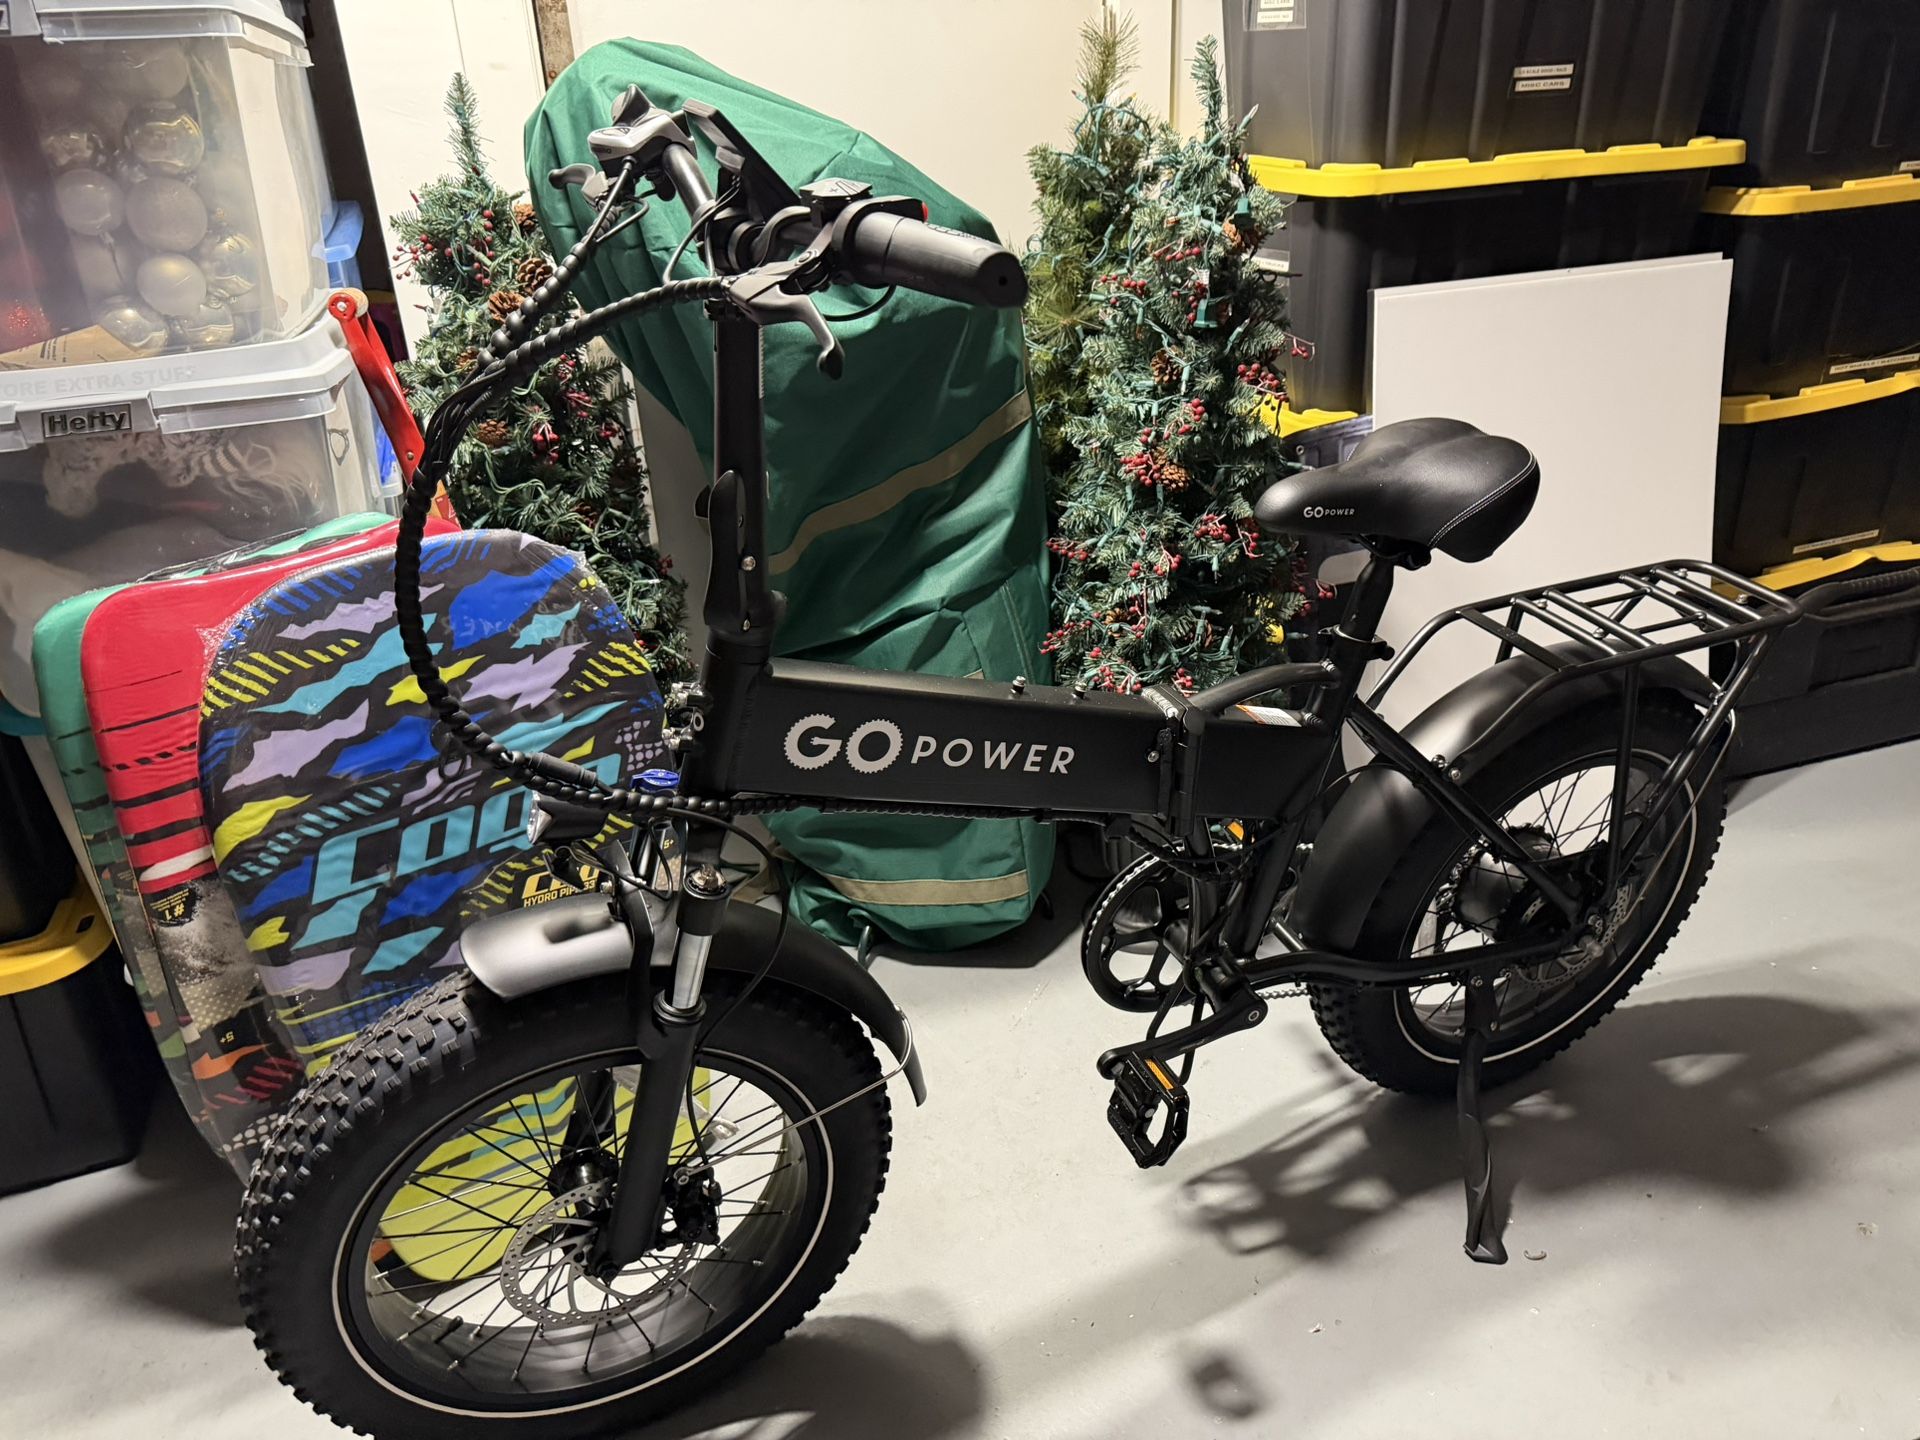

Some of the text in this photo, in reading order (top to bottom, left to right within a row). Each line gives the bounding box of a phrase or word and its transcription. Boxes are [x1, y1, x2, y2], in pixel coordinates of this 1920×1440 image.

[0, 379, 47, 397] ORE
[55, 373, 124, 393] EXTRA
[49, 410, 128, 433] Hefty
[1303, 506, 1355, 518] GO POWER
[784, 713, 1075, 774] GO POWER
[523, 891, 558, 907] HYDRO
[559, 886, 580, 898] PIP
